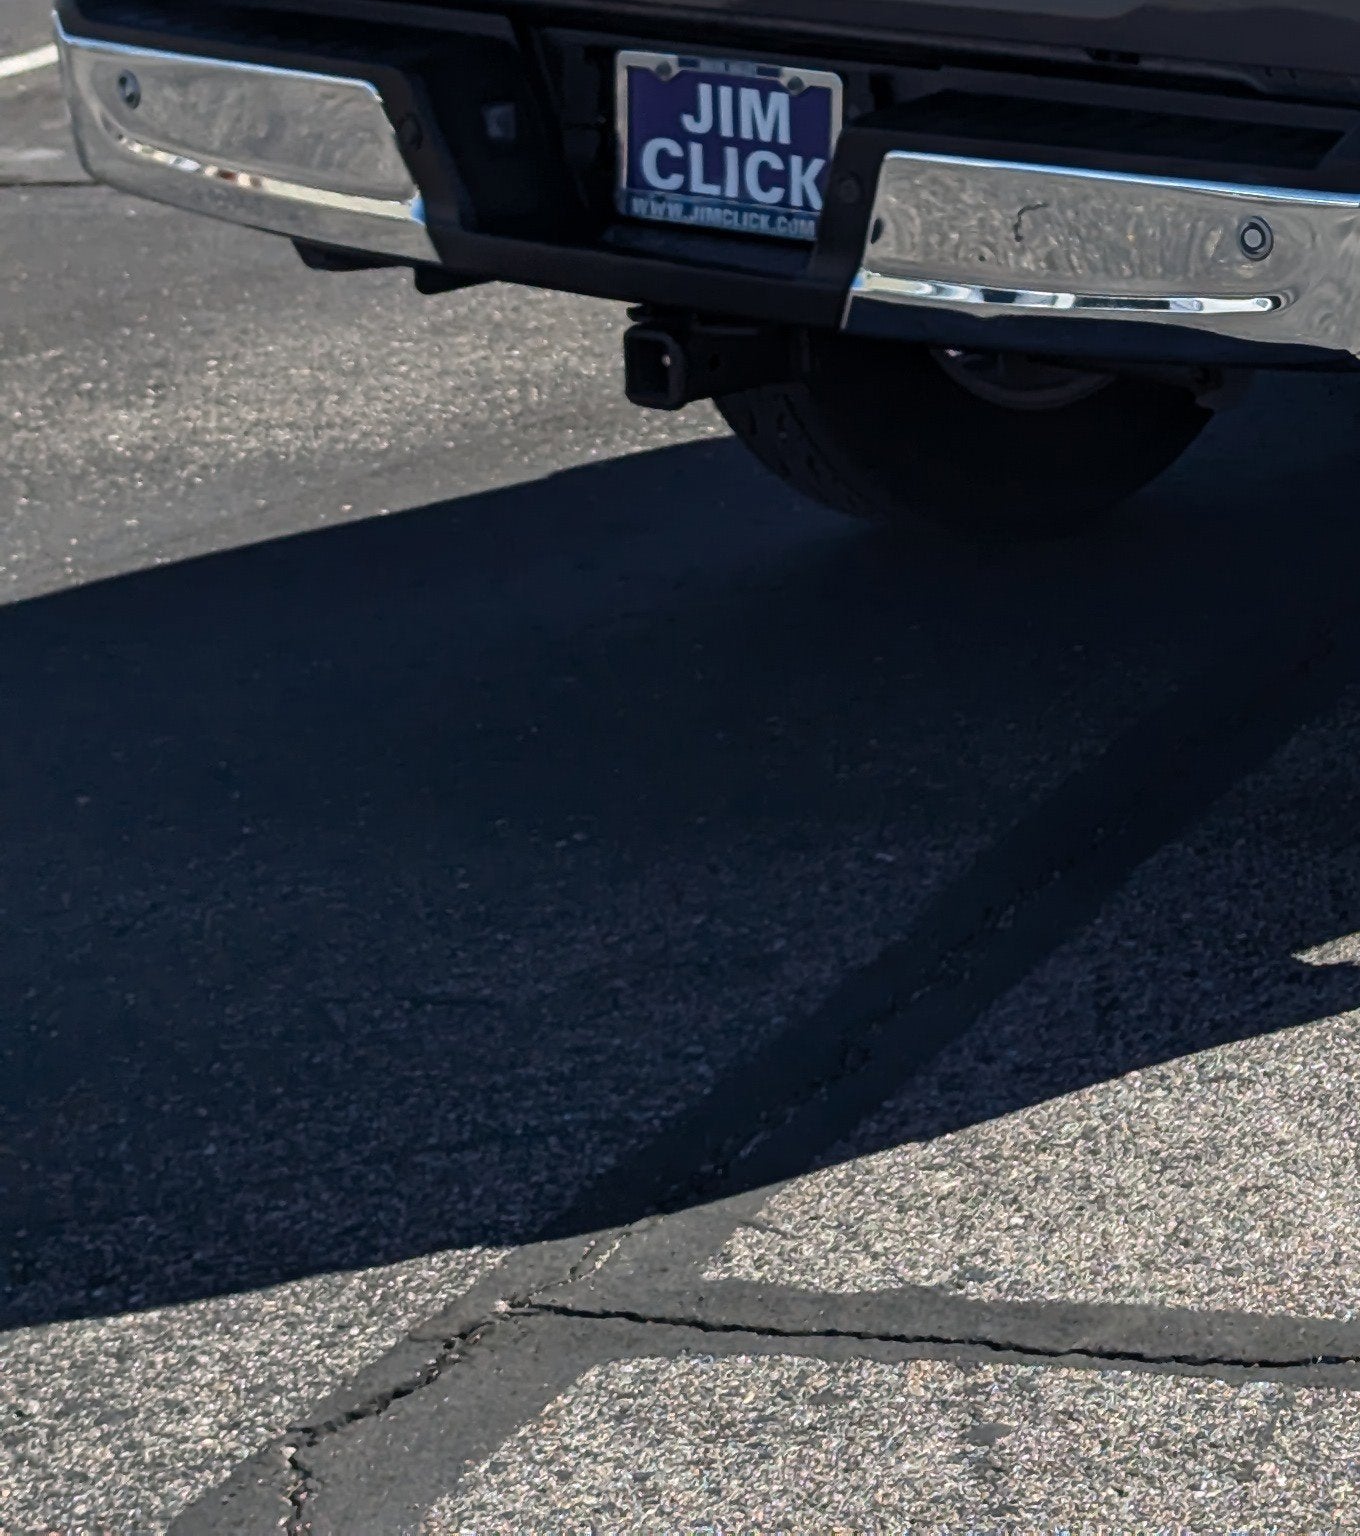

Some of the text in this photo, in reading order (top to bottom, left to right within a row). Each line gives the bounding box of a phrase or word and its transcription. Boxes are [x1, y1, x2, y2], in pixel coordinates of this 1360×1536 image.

[680, 82, 791, 145] JIM
[641, 137, 826, 211] CLICK
[631, 196, 817, 237] WWW.JIMCLICK.COM
